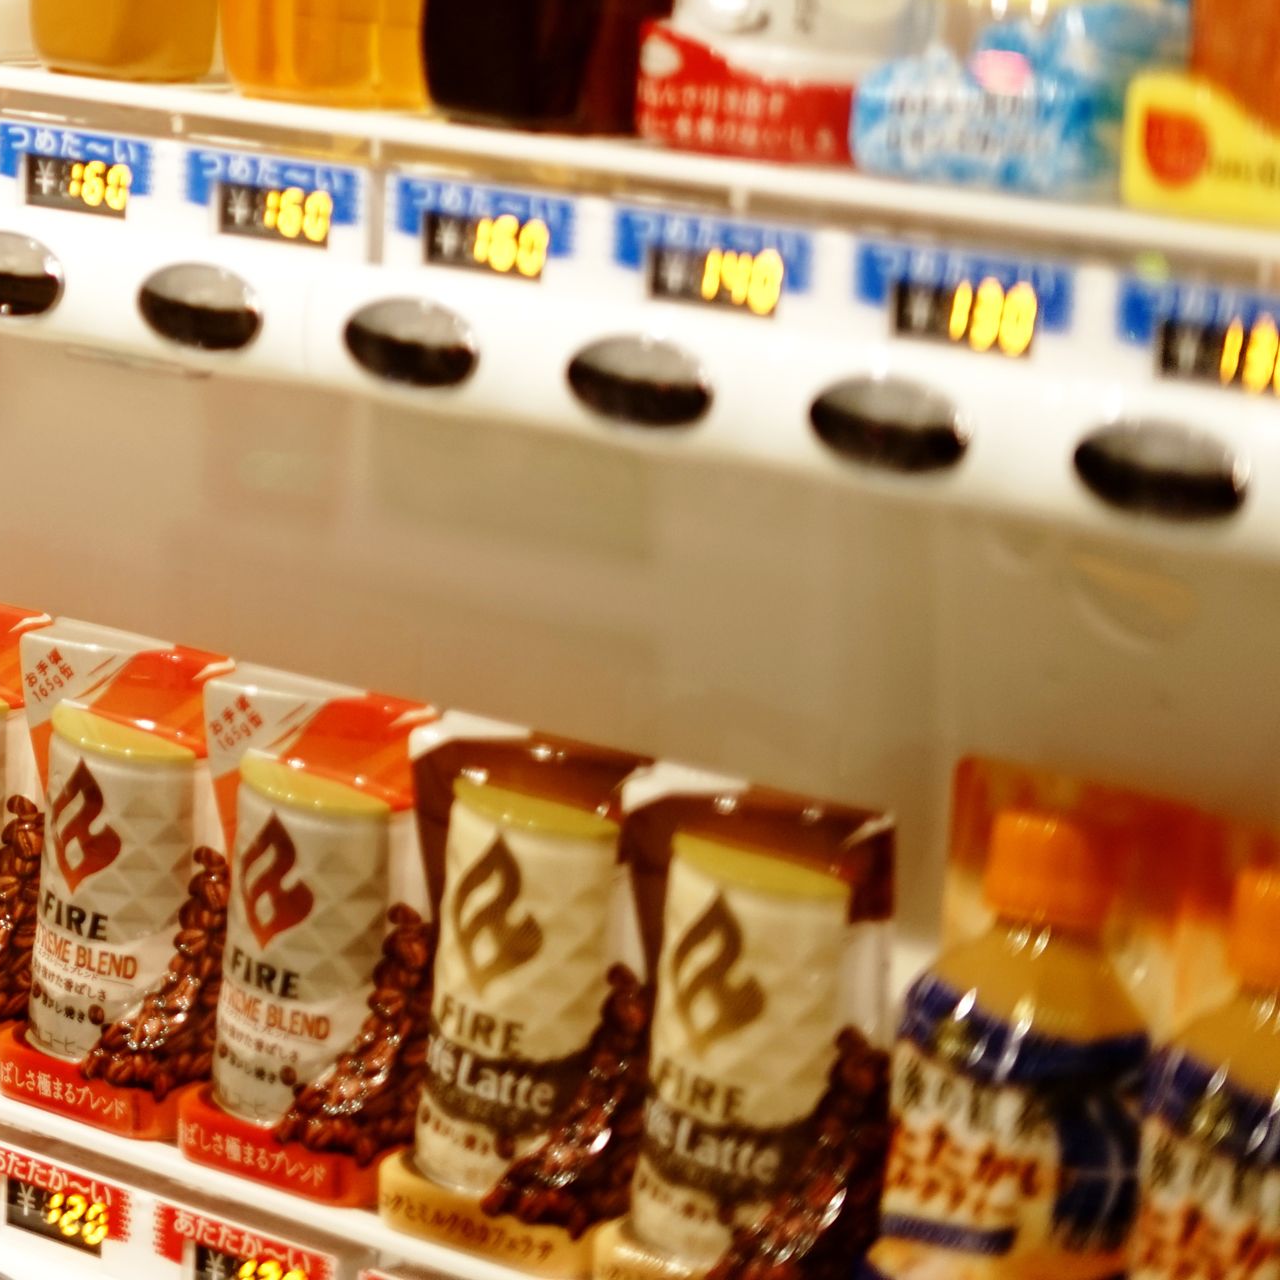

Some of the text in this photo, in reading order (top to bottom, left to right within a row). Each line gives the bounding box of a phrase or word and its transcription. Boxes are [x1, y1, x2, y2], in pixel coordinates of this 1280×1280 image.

[34, 160, 133, 211] ¥160
[43, 890, 109, 941] FIRE
[76, 945, 138, 980] BLEND
[231, 946, 301, 999] FIRE
[266, 1005, 331, 1041] BLEND
[441, 995, 524, 1056] FIRE
[457, 1052, 556, 1116] Latte
[655, 1057, 748, 1120] FIRE
[675, 1120, 783, 1185] Latte
[17, 1183, 109, 1246] ¥120
